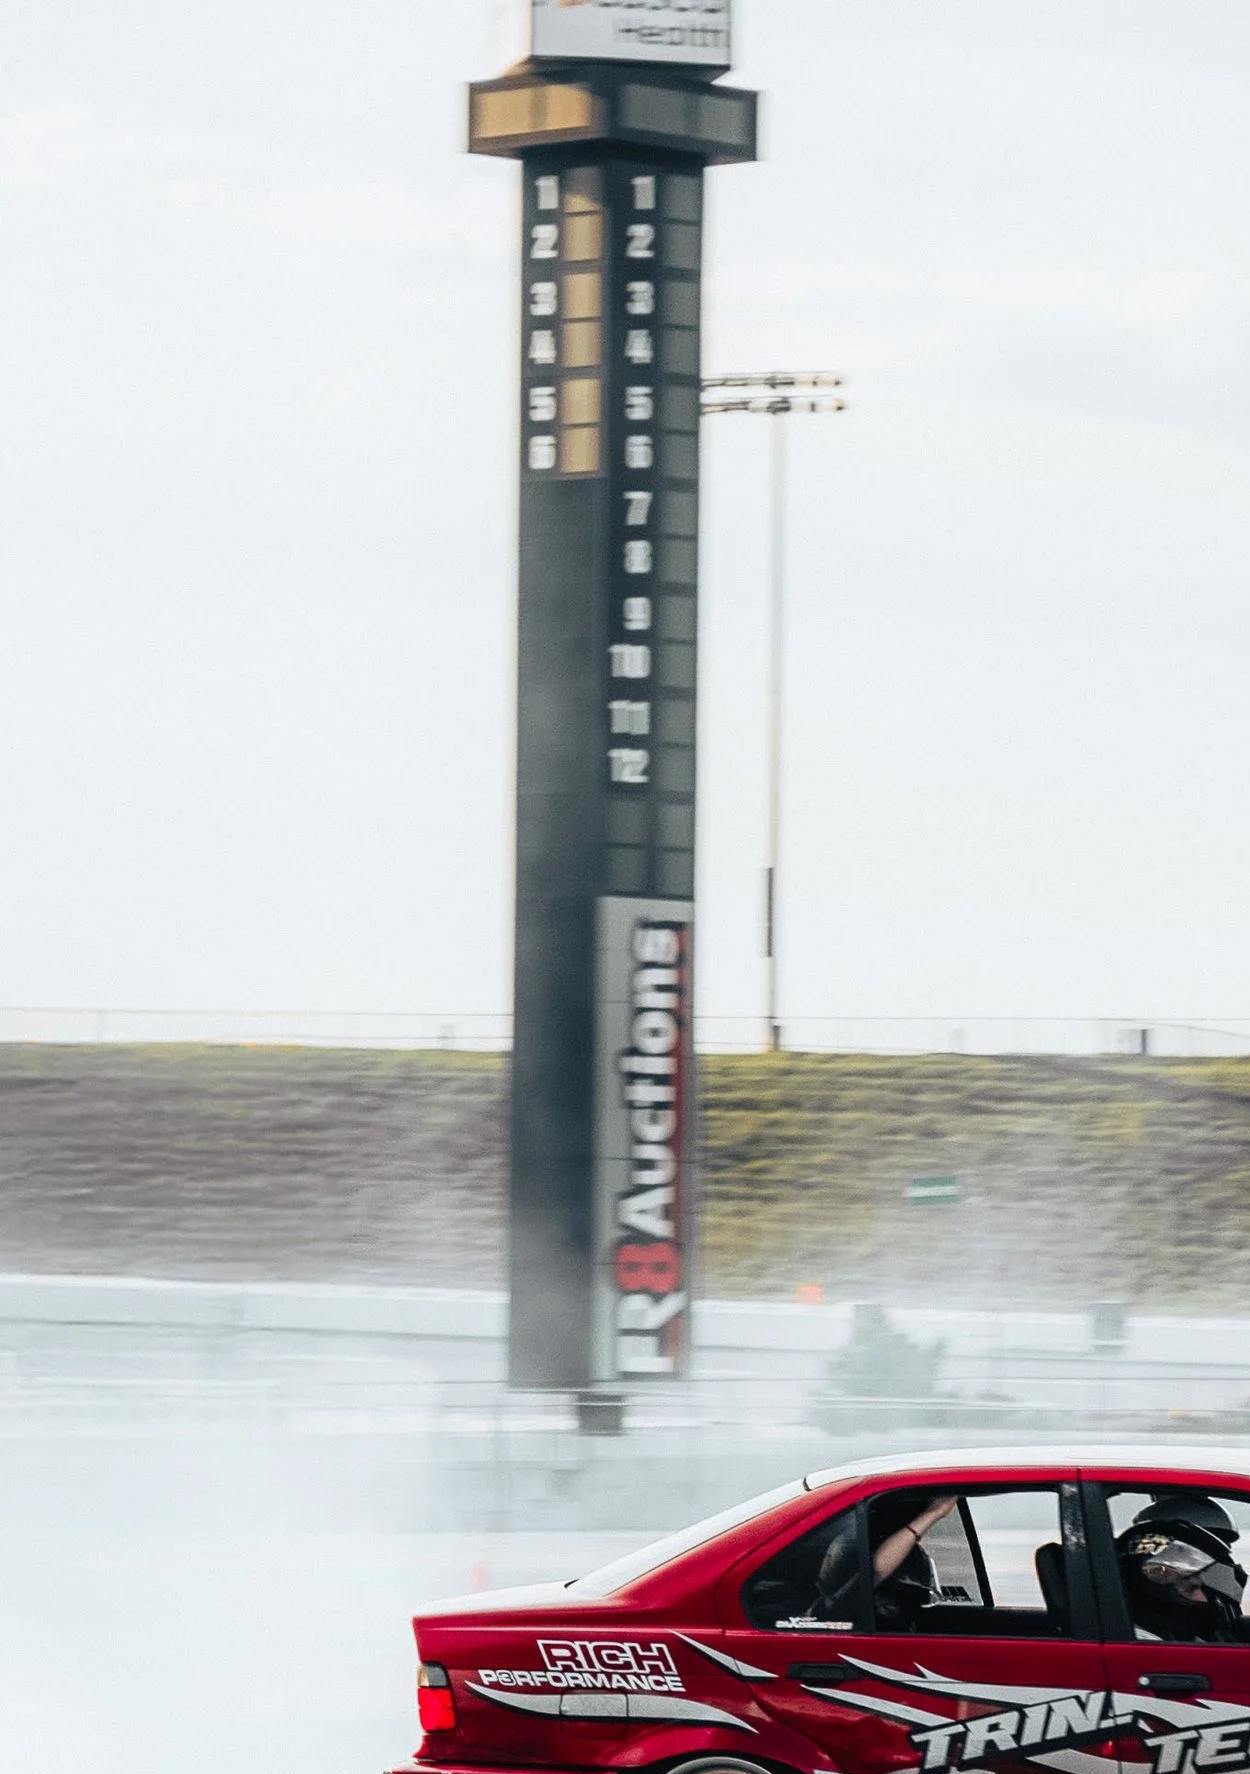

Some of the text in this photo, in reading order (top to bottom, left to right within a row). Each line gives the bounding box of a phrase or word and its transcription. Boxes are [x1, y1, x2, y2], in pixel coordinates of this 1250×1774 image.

[535, 175, 559, 210] 1
[631, 175, 656, 210] 1
[530, 224, 559, 259] 2
[626, 223, 655, 258] 2
[529, 281, 557, 316] 3
[626, 281, 655, 315] 3
[528, 329, 556, 364] 4
[624, 329, 654, 364] 4
[528, 386, 556, 421] 5
[624, 386, 654, 421] 5
[528, 435, 556, 470] 6
[624, 435, 654, 469] 6
[623, 491, 653, 525] 7
[623, 540, 652, 574] 8
[622, 597, 651, 631] 9
[609, 644, 650, 679] 10
[608, 699, 650, 735] 11
[607, 748, 650, 783] 12
[536, 1639, 679, 1675] RICH
